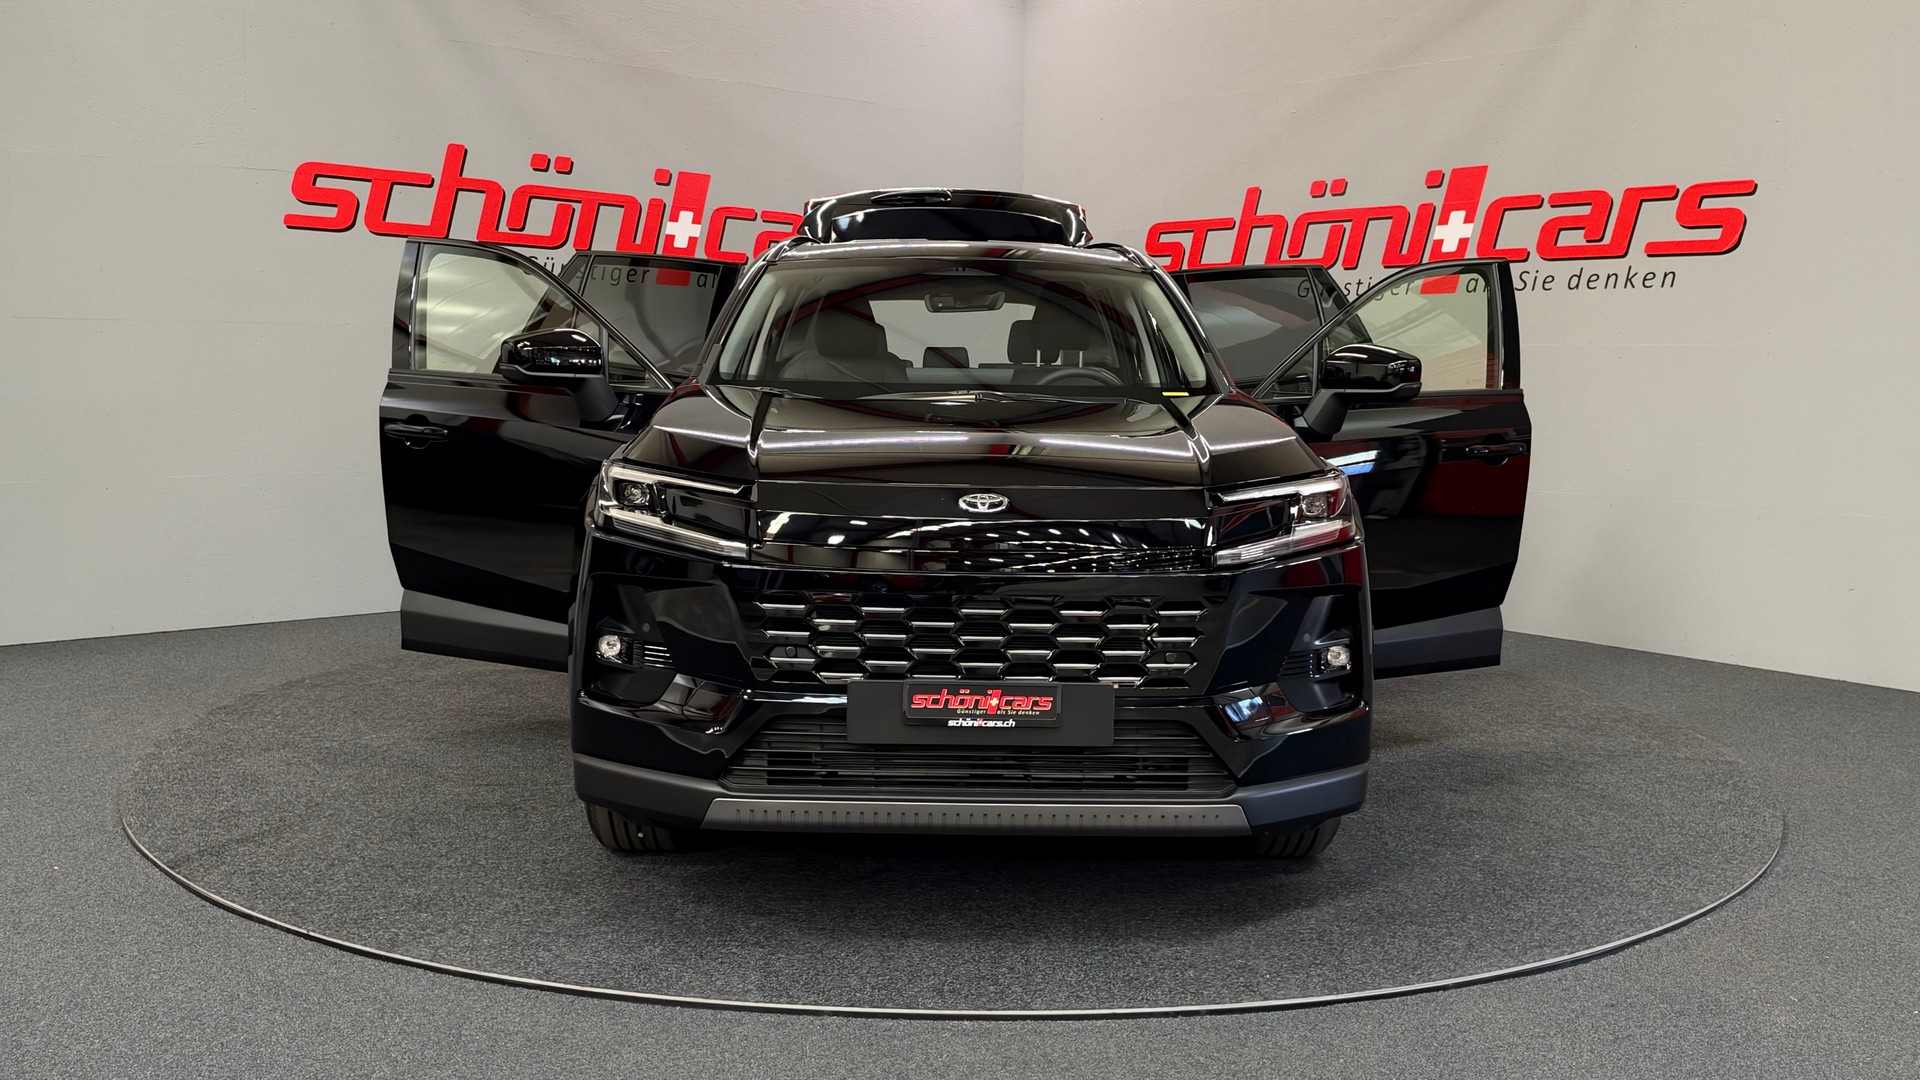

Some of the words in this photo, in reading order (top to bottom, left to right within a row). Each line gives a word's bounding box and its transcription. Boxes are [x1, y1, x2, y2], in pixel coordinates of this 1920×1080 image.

[1514, 269, 1555, 292] Sie
[1567, 265, 1677, 291] denken
[956, 708, 987, 716] Günstiger
